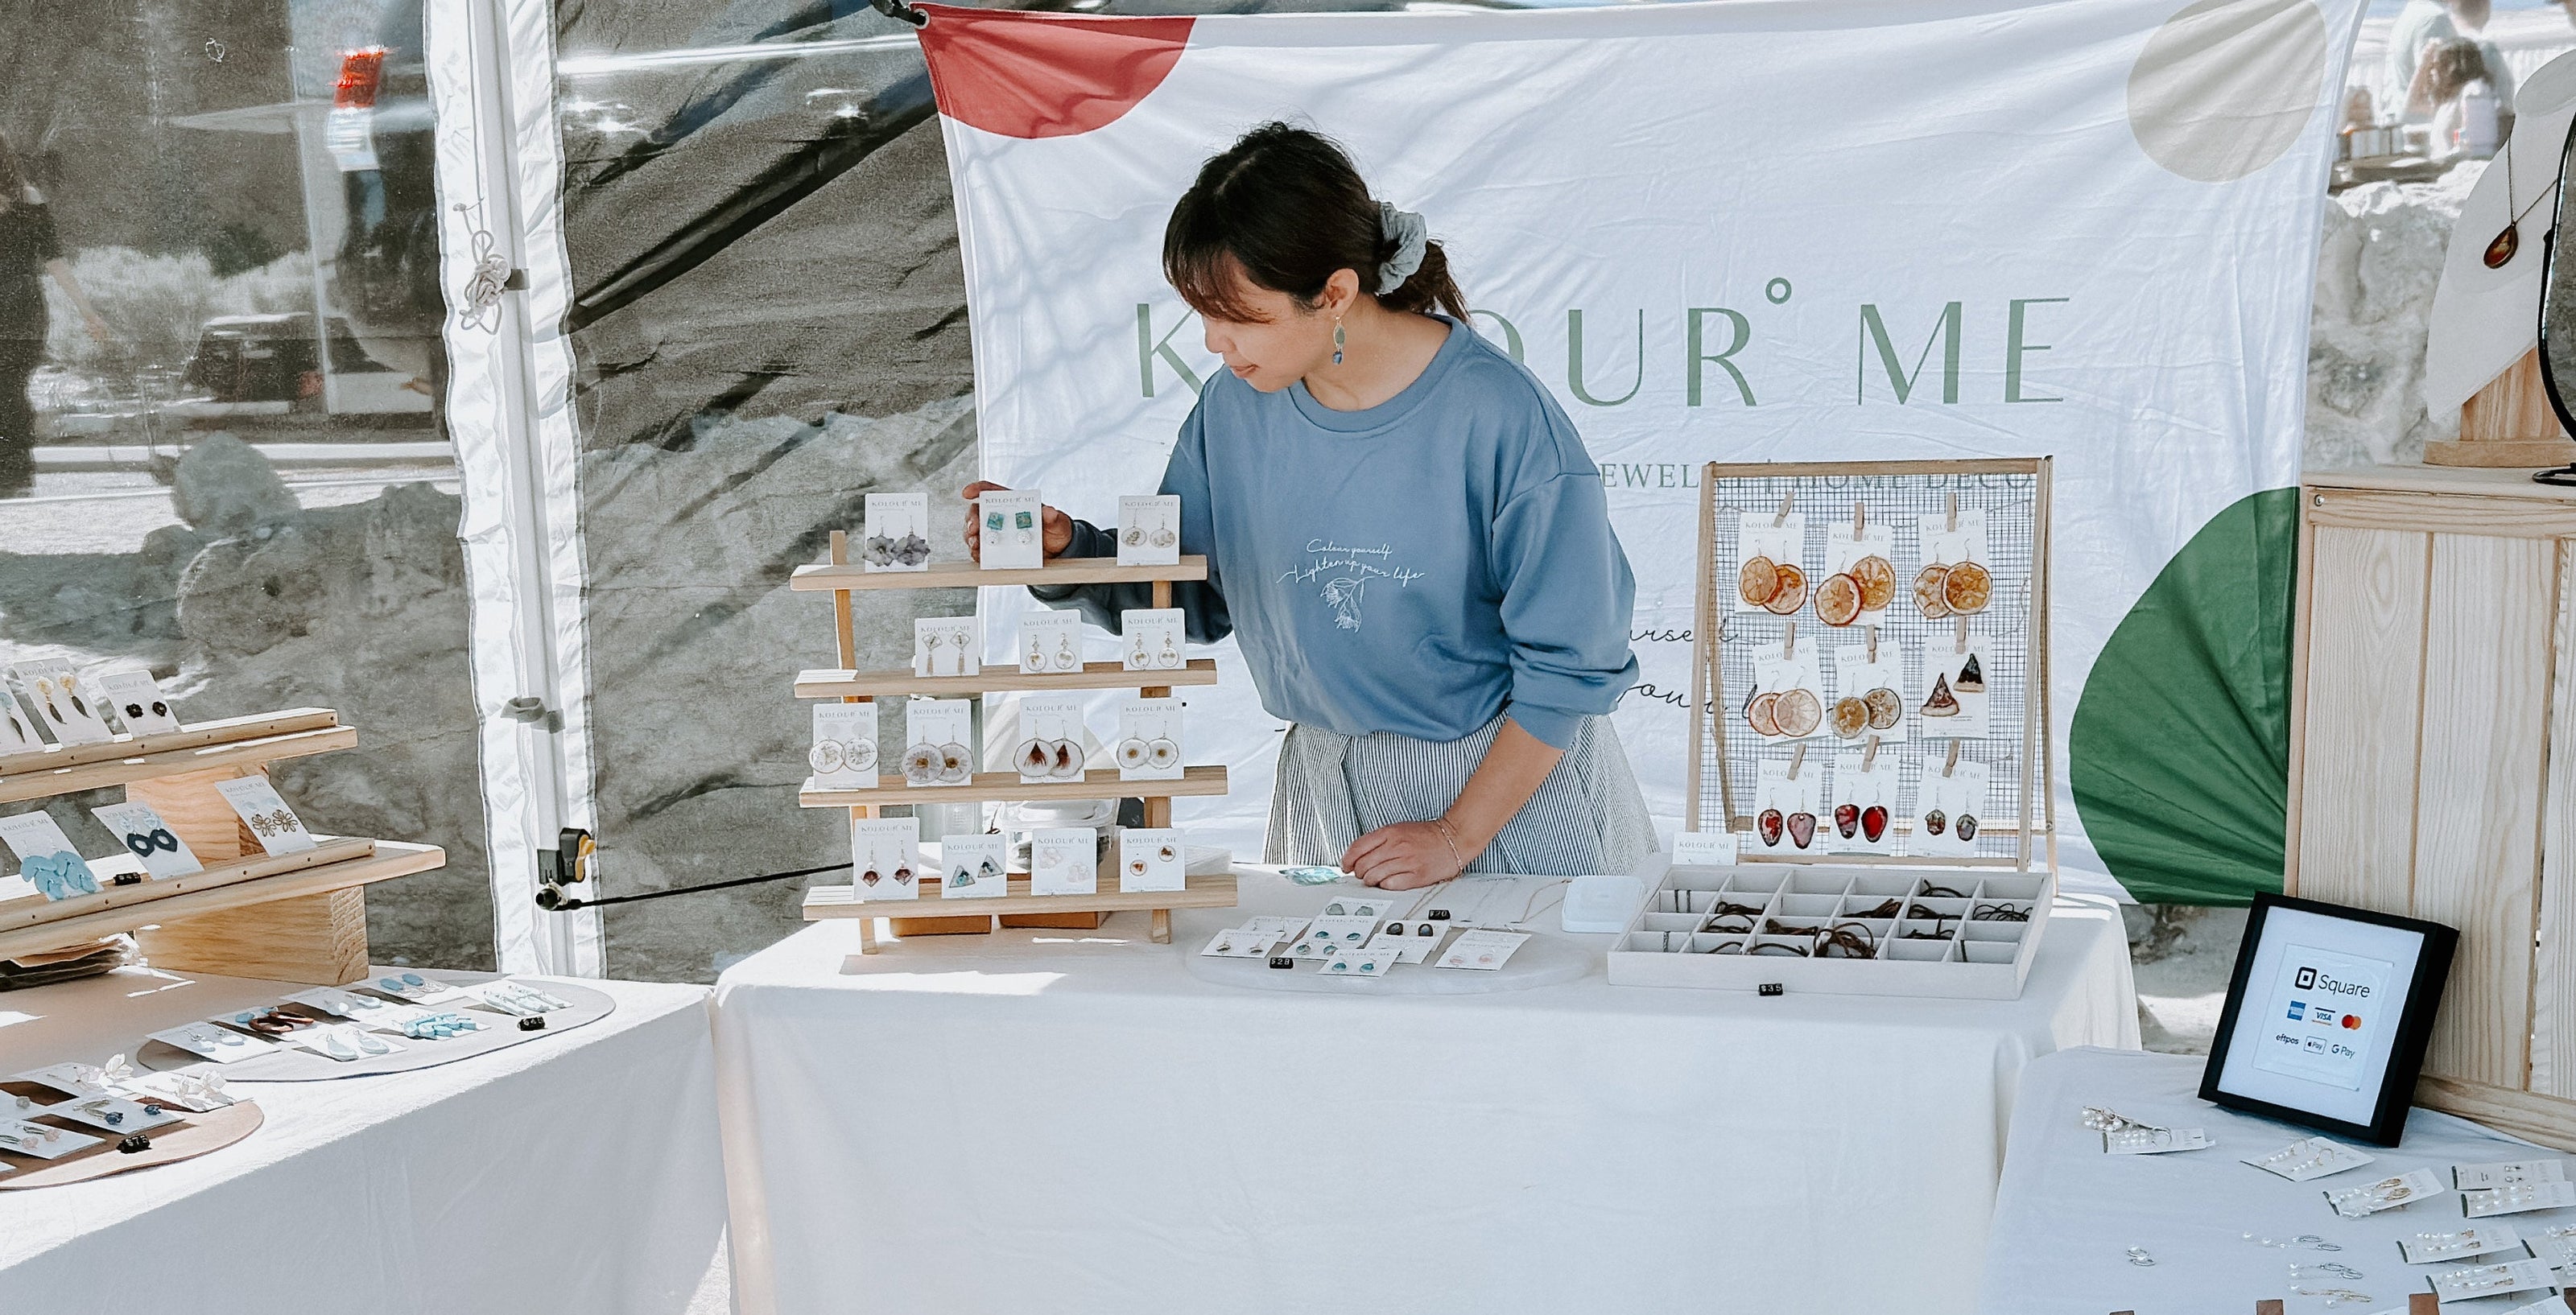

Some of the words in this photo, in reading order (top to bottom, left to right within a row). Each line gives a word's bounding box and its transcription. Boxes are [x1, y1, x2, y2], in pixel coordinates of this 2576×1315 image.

[1858, 298, 2070, 406] ME
[1307, 538, 1350, 553] Colour
[1351, 543, 1393, 560] yourself
[1343, 559, 1360, 572] up
[1360, 562, 1390, 577] your
[1393, 567, 1425, 587] life
[1271, 958, 1290, 966] $28
[1761, 983, 1781, 992] $35
[2318, 975, 2370, 998] Square
[2317, 1012, 2332, 1021] VISA
[2276, 1033, 2299, 1045] eftpos
[2341, 1046, 2355, 1059] Pay
